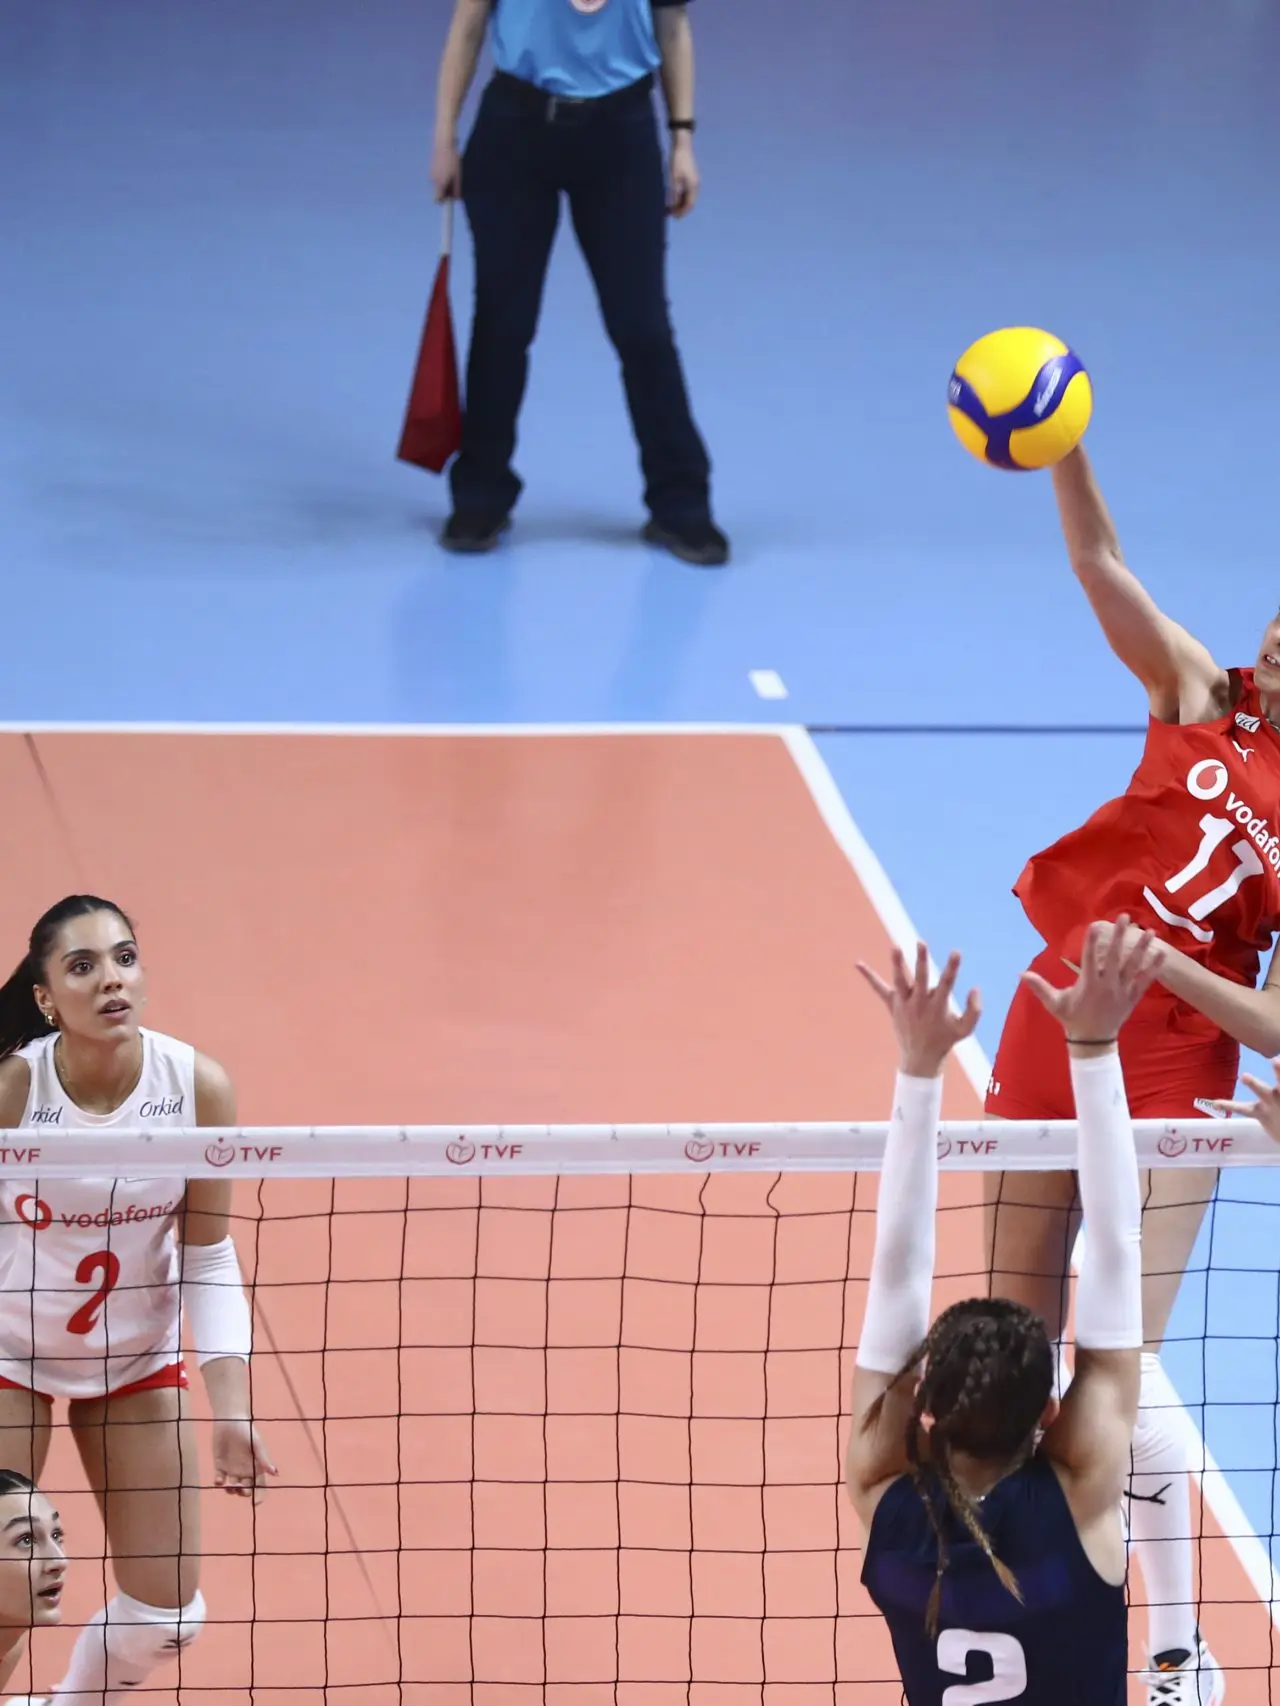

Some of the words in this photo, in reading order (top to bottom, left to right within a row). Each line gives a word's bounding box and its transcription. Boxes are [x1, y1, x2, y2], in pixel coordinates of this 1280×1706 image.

[1164, 813, 1265, 921] 17
[31, 1105, 63, 1124] rkid
[140, 1096, 184, 1118] Orkid
[481, 1144, 524, 1159] TVF
[719, 1142, 762, 1157] TVF
[956, 1140, 999, 1155] TVF
[1192, 1138, 1234, 1152] TVF
[0, 1148, 41, 1164] TVF
[240, 1146, 284, 1162] TVF
[61, 1201, 173, 1228] vodafone
[66, 1250, 121, 1334] 2
[937, 1628, 1027, 1706] 2
